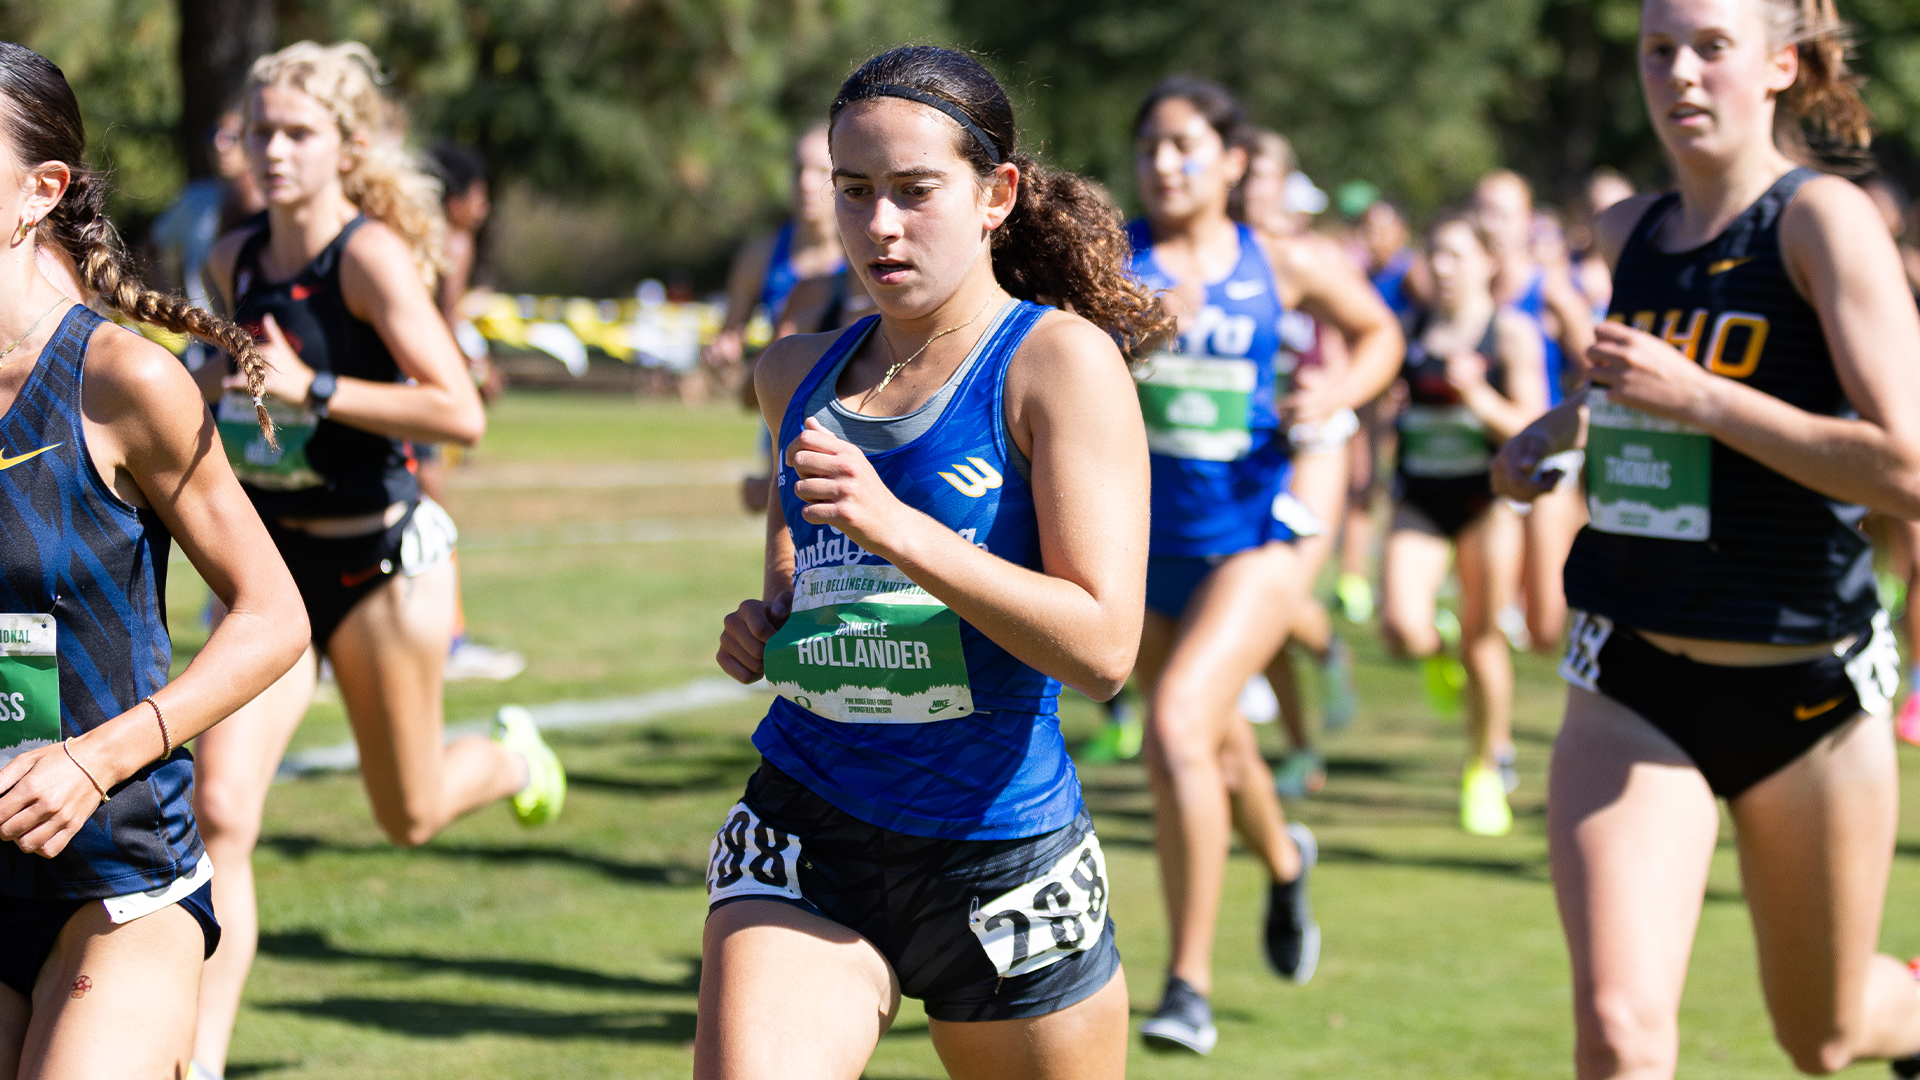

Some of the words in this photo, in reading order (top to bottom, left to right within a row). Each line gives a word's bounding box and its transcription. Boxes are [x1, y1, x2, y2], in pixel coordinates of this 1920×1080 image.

[1605, 455, 1672, 489] THOMAS
[810, 581, 825, 596] BILL
[825, 577, 873, 593] DELLINGER
[876, 580, 931, 596] INVITATIO
[836, 622, 888, 638] DANIELLE
[797, 636, 932, 670] HOLLANDER
[932, 700, 951, 708] NIKE
